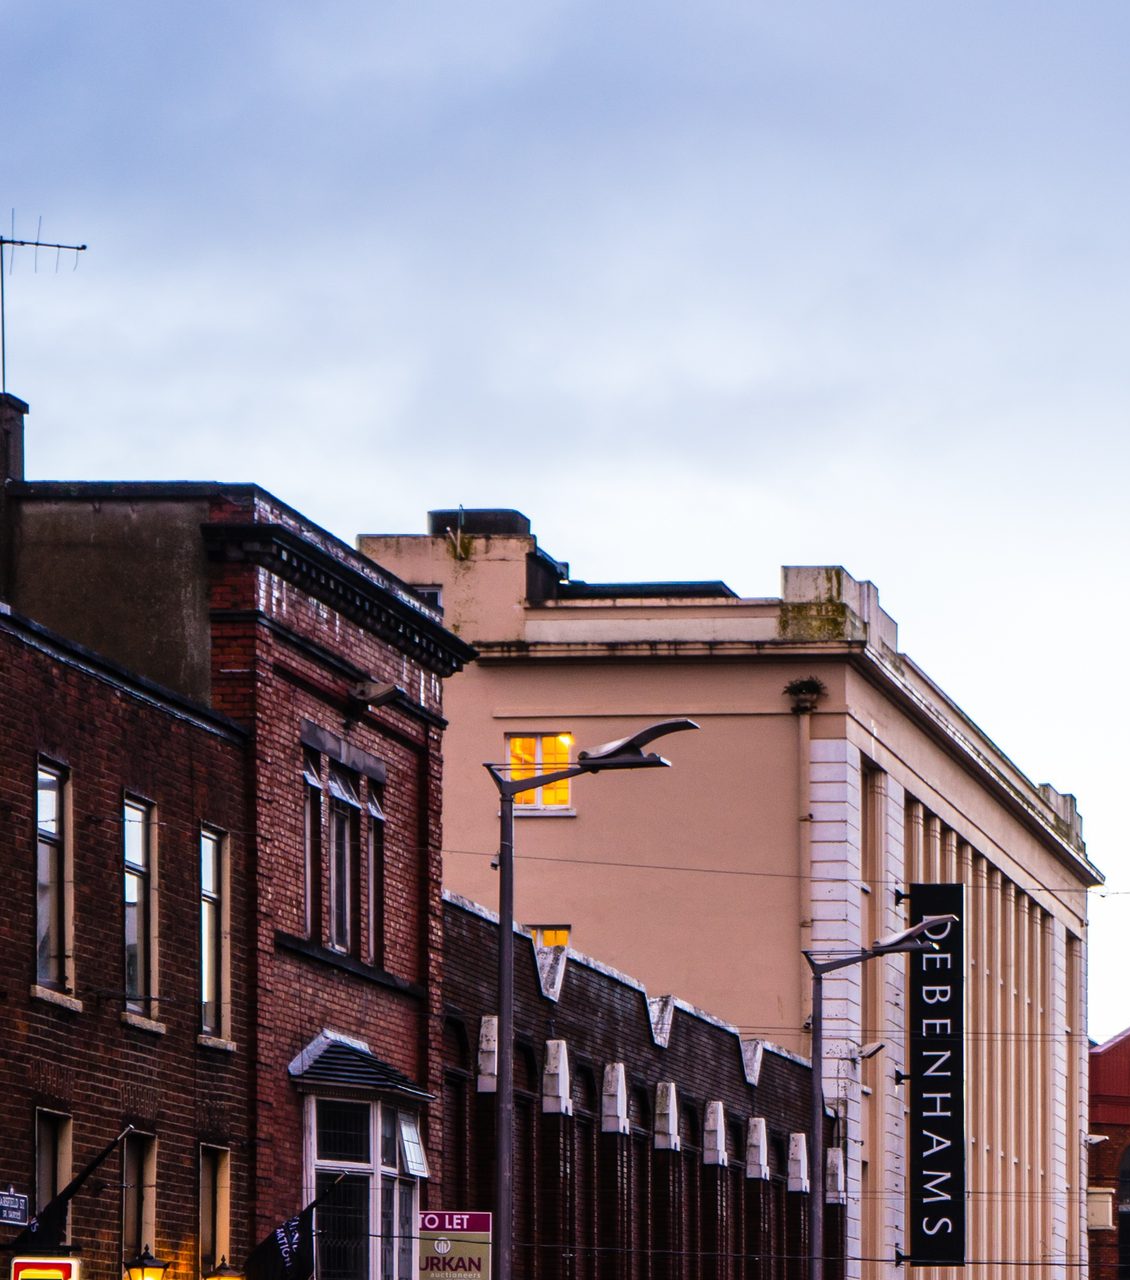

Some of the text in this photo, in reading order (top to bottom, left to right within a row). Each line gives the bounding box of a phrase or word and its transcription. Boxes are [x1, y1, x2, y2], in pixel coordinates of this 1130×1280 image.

[922, 914, 952, 1235] DEBENHAMS
[419, 1214, 470, 1229] TO LET
